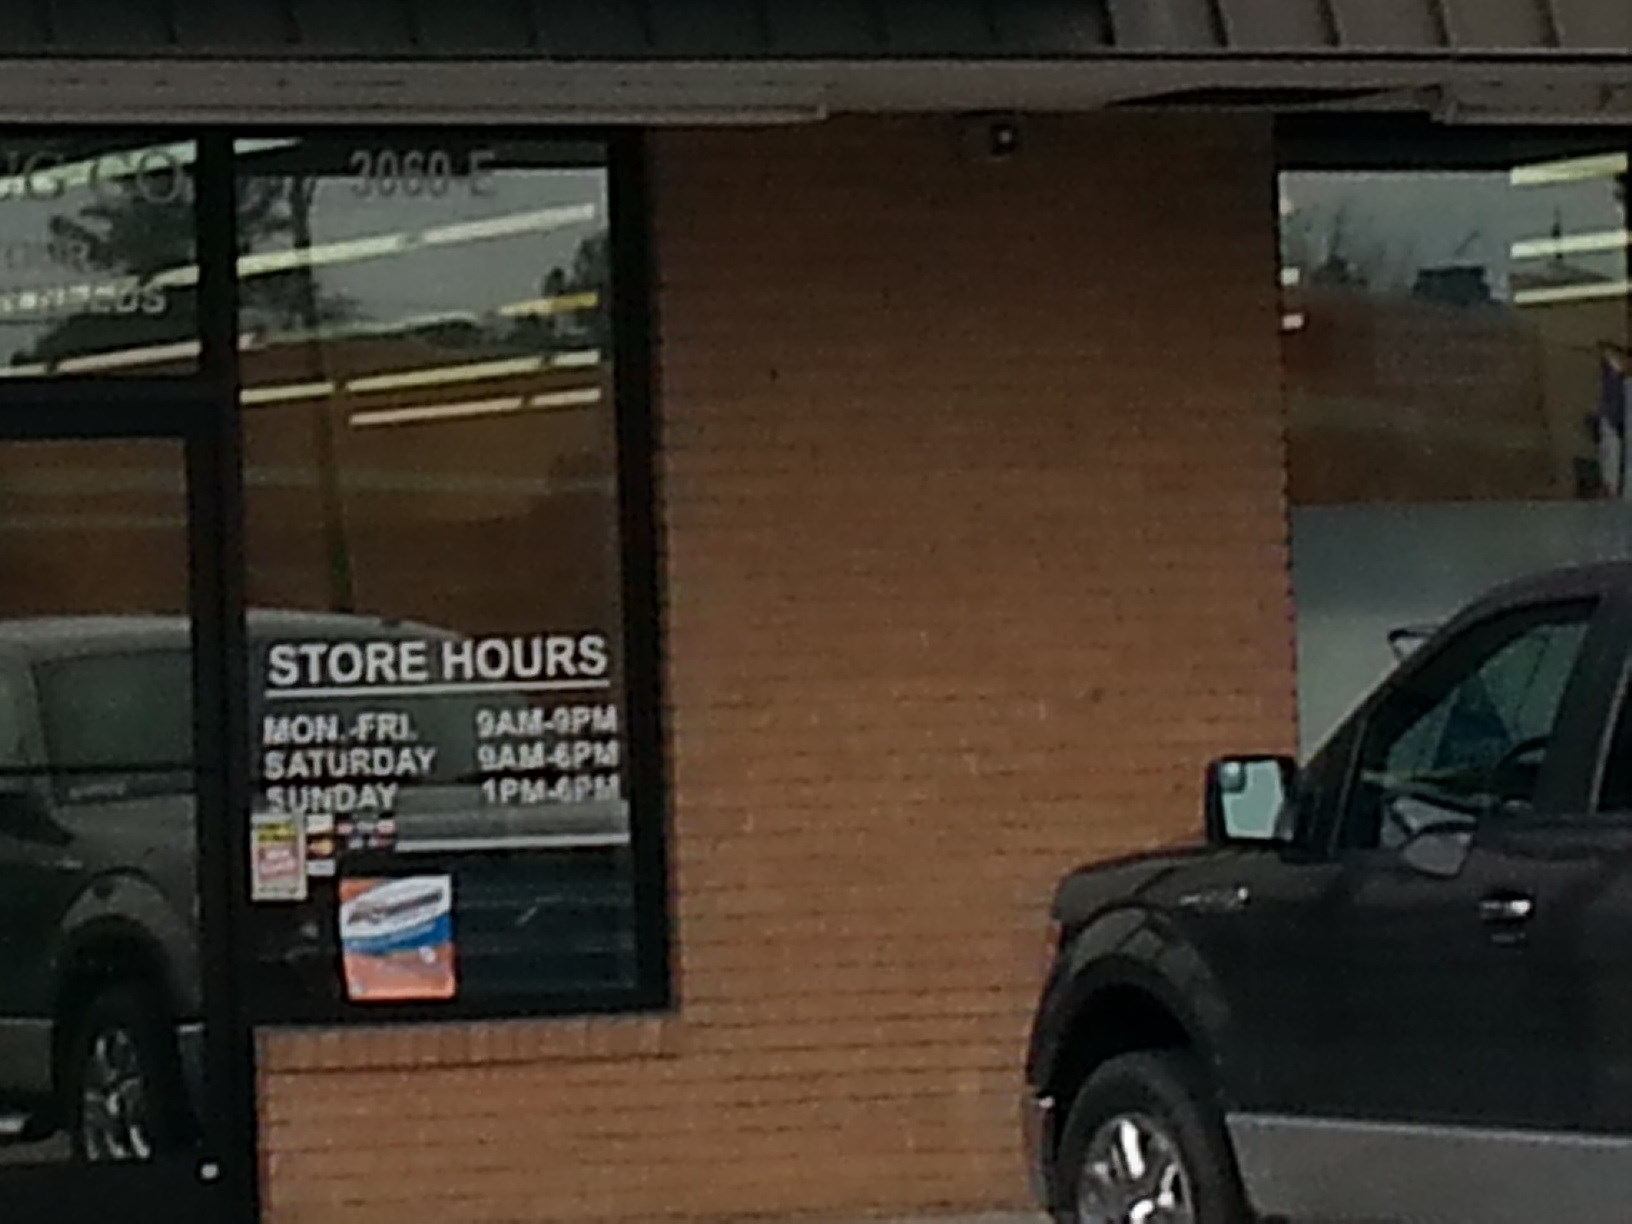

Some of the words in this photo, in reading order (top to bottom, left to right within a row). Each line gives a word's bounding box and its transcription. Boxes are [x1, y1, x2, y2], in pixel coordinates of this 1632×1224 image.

[269, 641, 429, 686] STORE
[441, 634, 609, 679] HOURS
[266, 747, 437, 781] SATURDAY
[267, 782, 399, 814] SUNDAY
